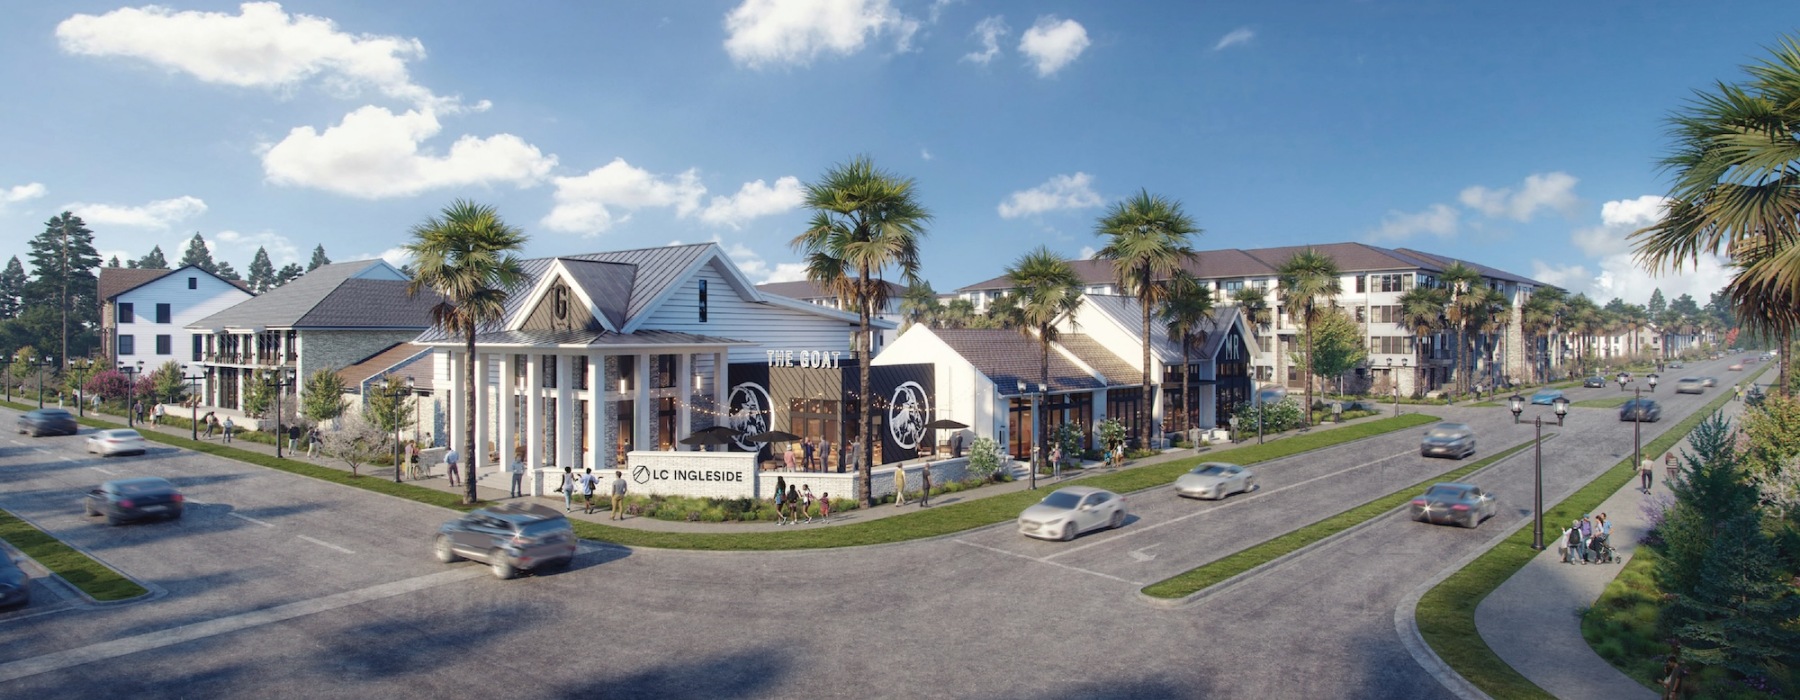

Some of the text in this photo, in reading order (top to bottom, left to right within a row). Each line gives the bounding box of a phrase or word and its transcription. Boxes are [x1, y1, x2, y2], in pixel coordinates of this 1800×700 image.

[555, 284, 567, 320] G
[767, 350, 841, 369] THE GOAT
[653, 470, 743, 482] LC INGLESIDE
